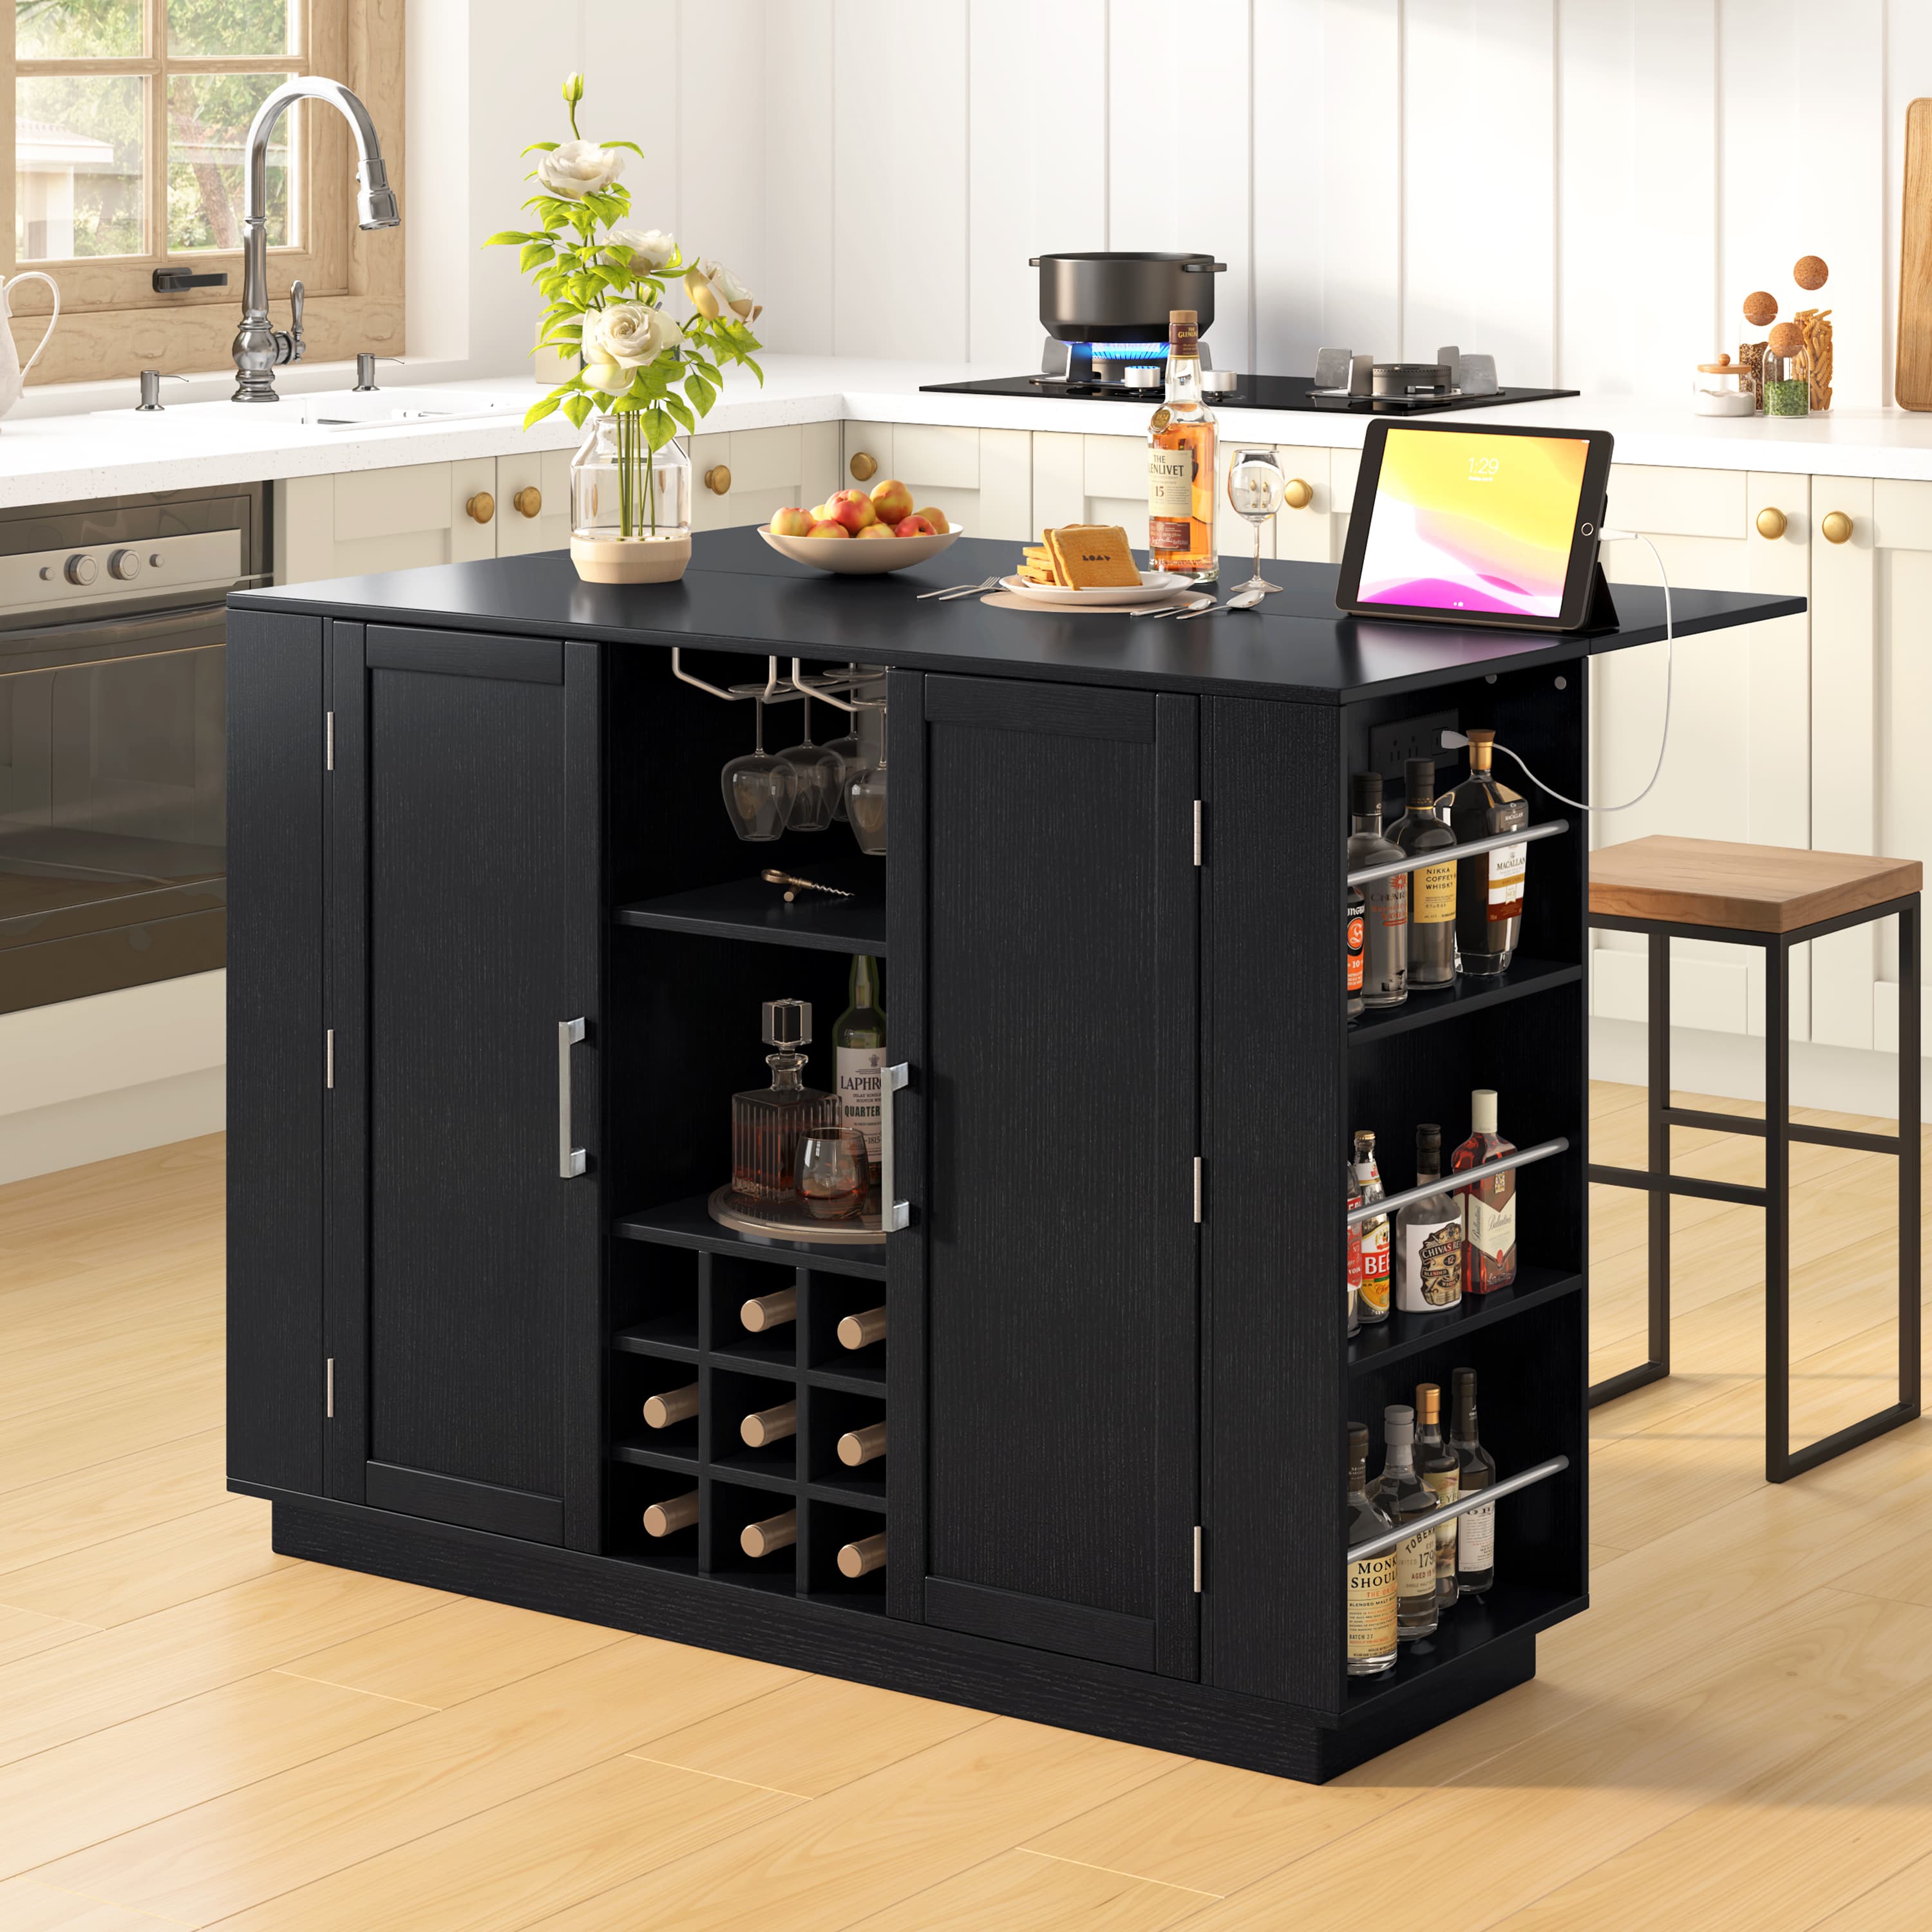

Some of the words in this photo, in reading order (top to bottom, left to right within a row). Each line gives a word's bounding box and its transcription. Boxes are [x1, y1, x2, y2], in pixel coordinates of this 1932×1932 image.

[1153, 455, 1166, 463] THE
[1468, 457, 1499, 475] 1:29
[1155, 486, 1164, 497] 15
[1352, 960, 1360, 968] 10
[844, 1105, 880, 1117] QUARTER
[1422, 1243, 1452, 1258] CHIVAS
[1412, 1571, 1425, 1580] AGED
